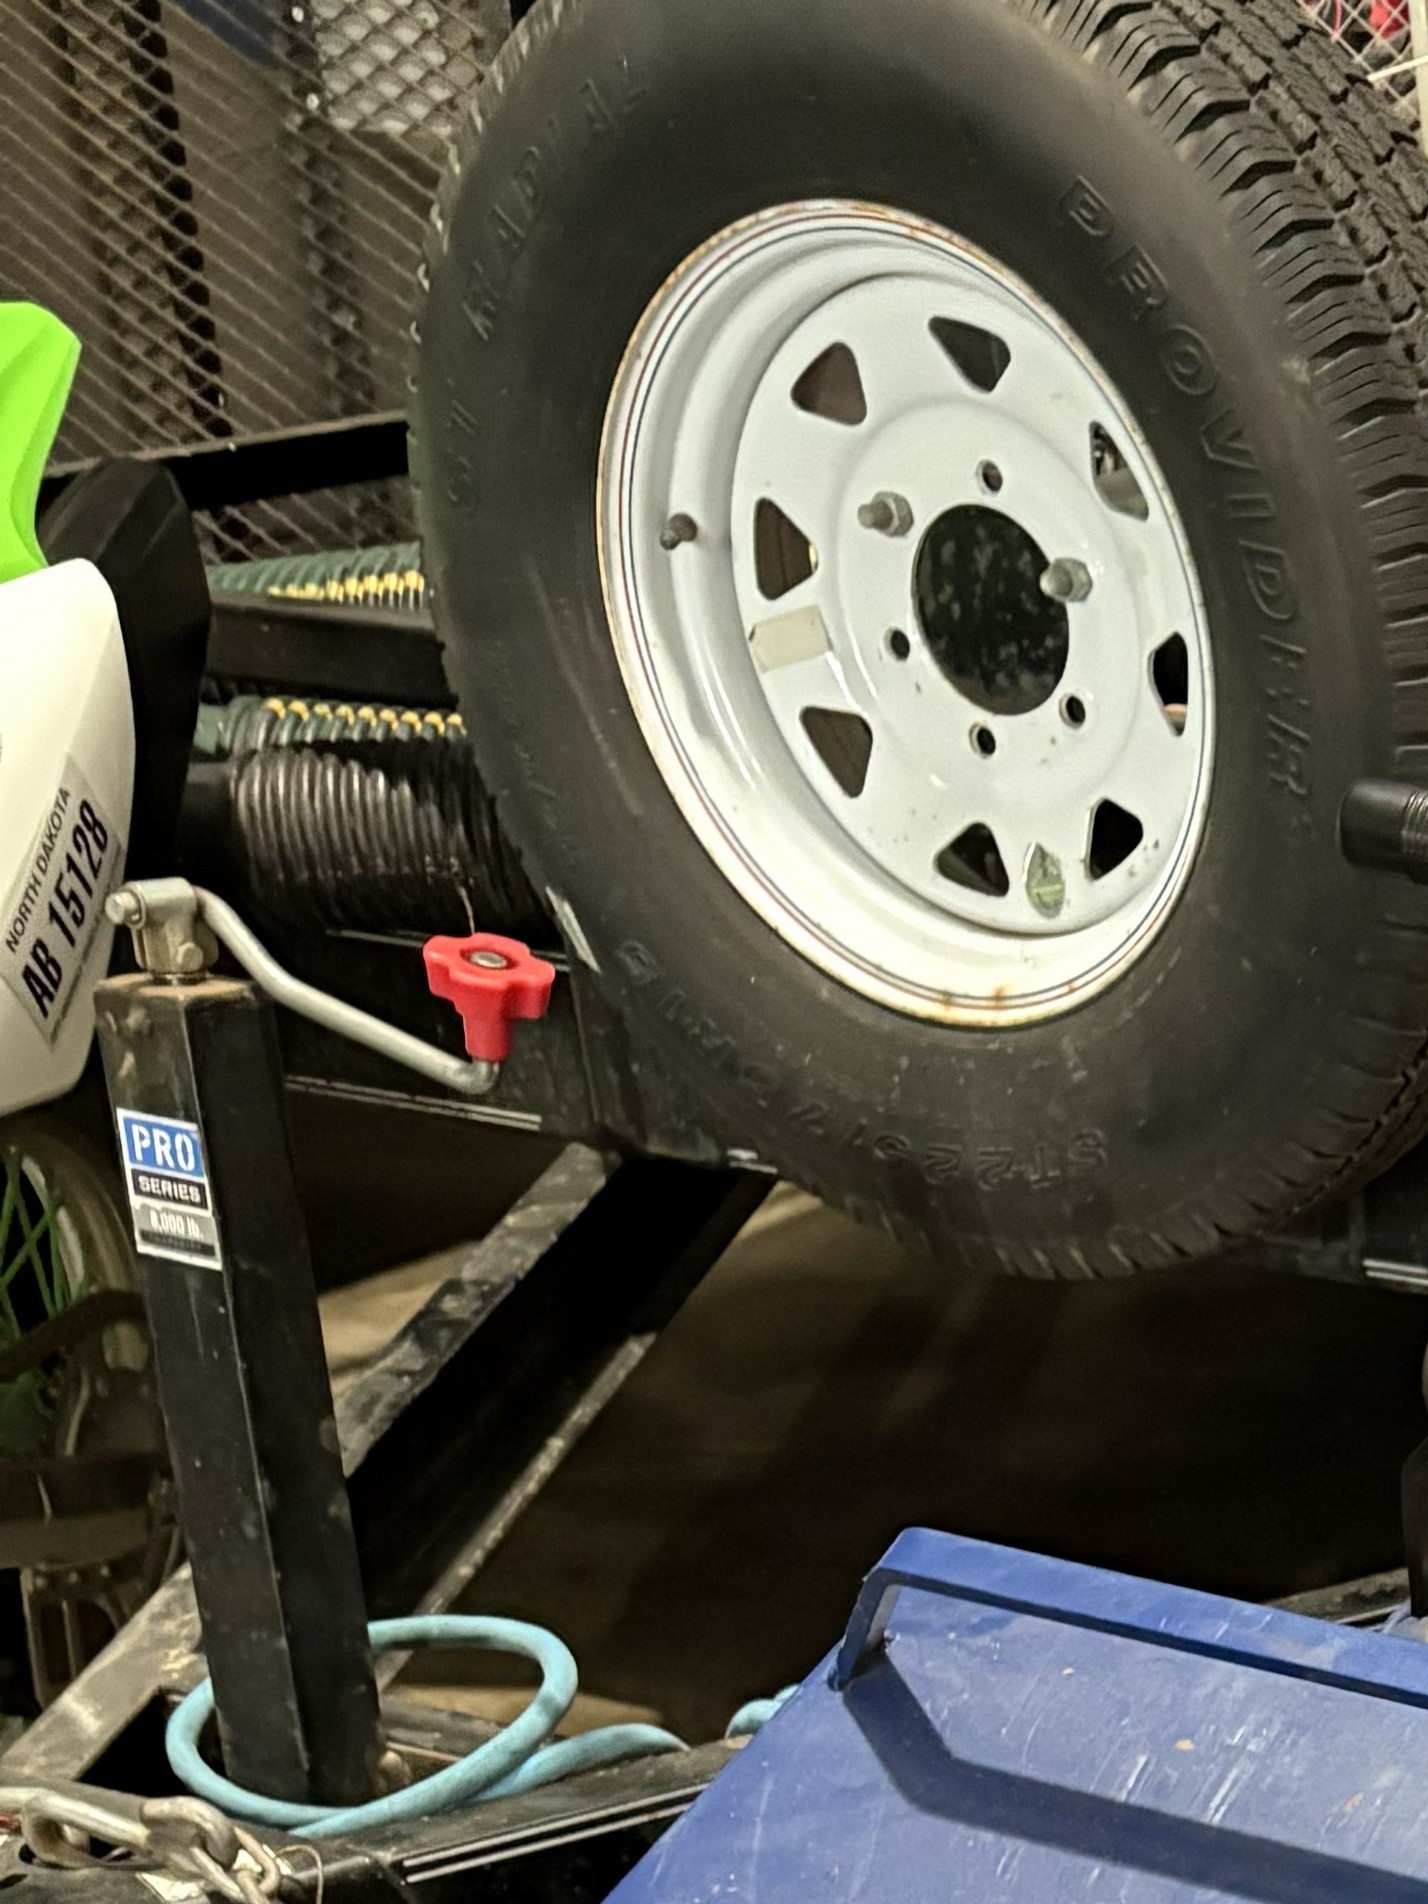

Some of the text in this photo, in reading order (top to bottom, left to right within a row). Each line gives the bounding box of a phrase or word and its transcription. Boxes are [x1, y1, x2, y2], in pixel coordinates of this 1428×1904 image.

[1059, 174, 1313, 798] PROVIDER
[4, 786, 71, 955] NORTH DAKOTA
[22, 936, 63, 1020] AB
[48, 799, 109, 949] 15128
[131, 1123, 196, 1172] PRO
[138, 1174, 201, 1203] SERIES
